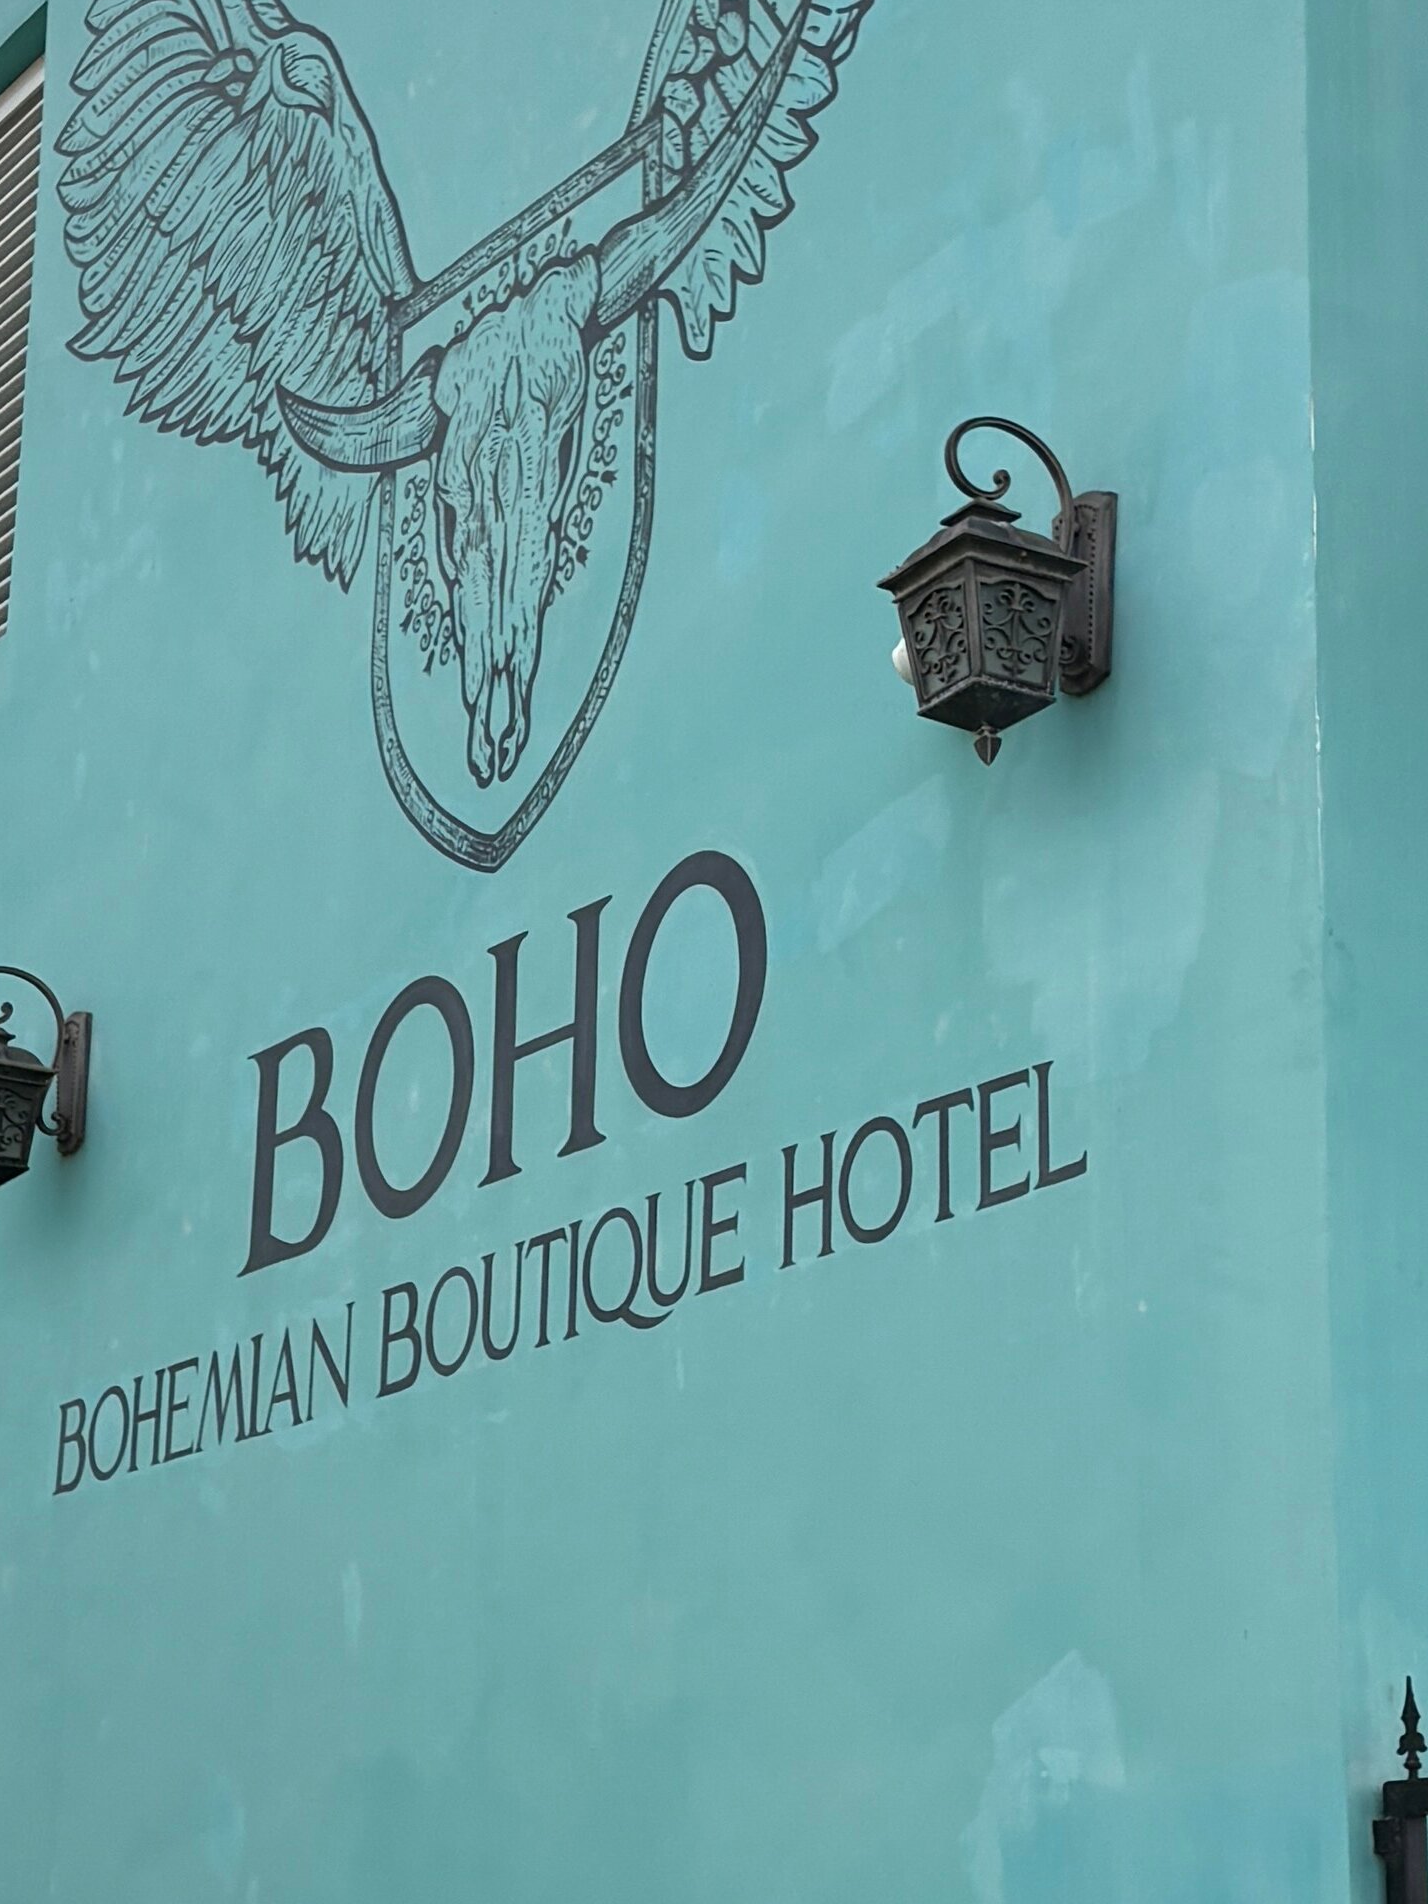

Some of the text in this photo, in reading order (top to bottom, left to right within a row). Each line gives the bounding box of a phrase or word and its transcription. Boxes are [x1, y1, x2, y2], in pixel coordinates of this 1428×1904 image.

[52, 1060, 1088, 1496] BOHEMIAN BOUTIQUE HOTEL
[236, 850, 768, 1278] BOHO
